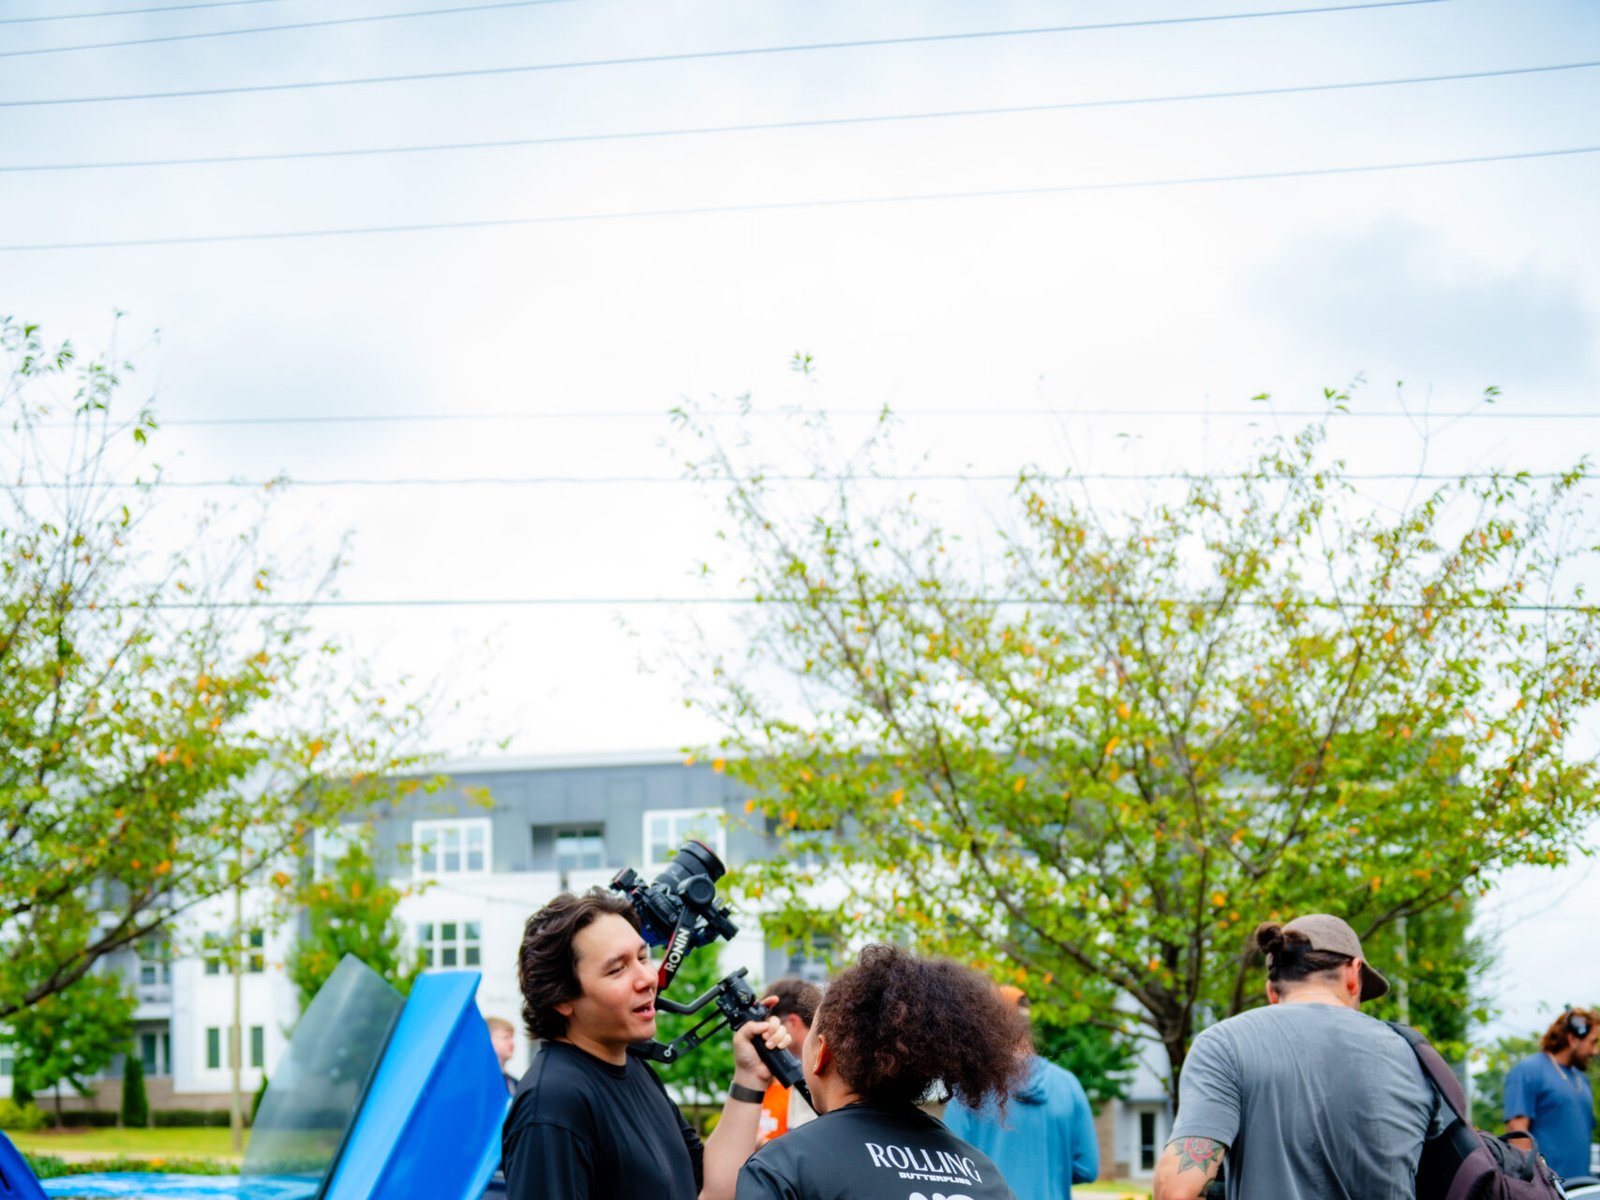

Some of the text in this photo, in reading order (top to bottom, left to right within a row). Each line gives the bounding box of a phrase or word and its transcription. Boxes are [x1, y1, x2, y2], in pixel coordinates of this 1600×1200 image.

[664, 927, 690, 972] RONIN
[864, 1142, 982, 1183] ROLLING
[899, 1171, 972, 1186] BUTTERFLIES
